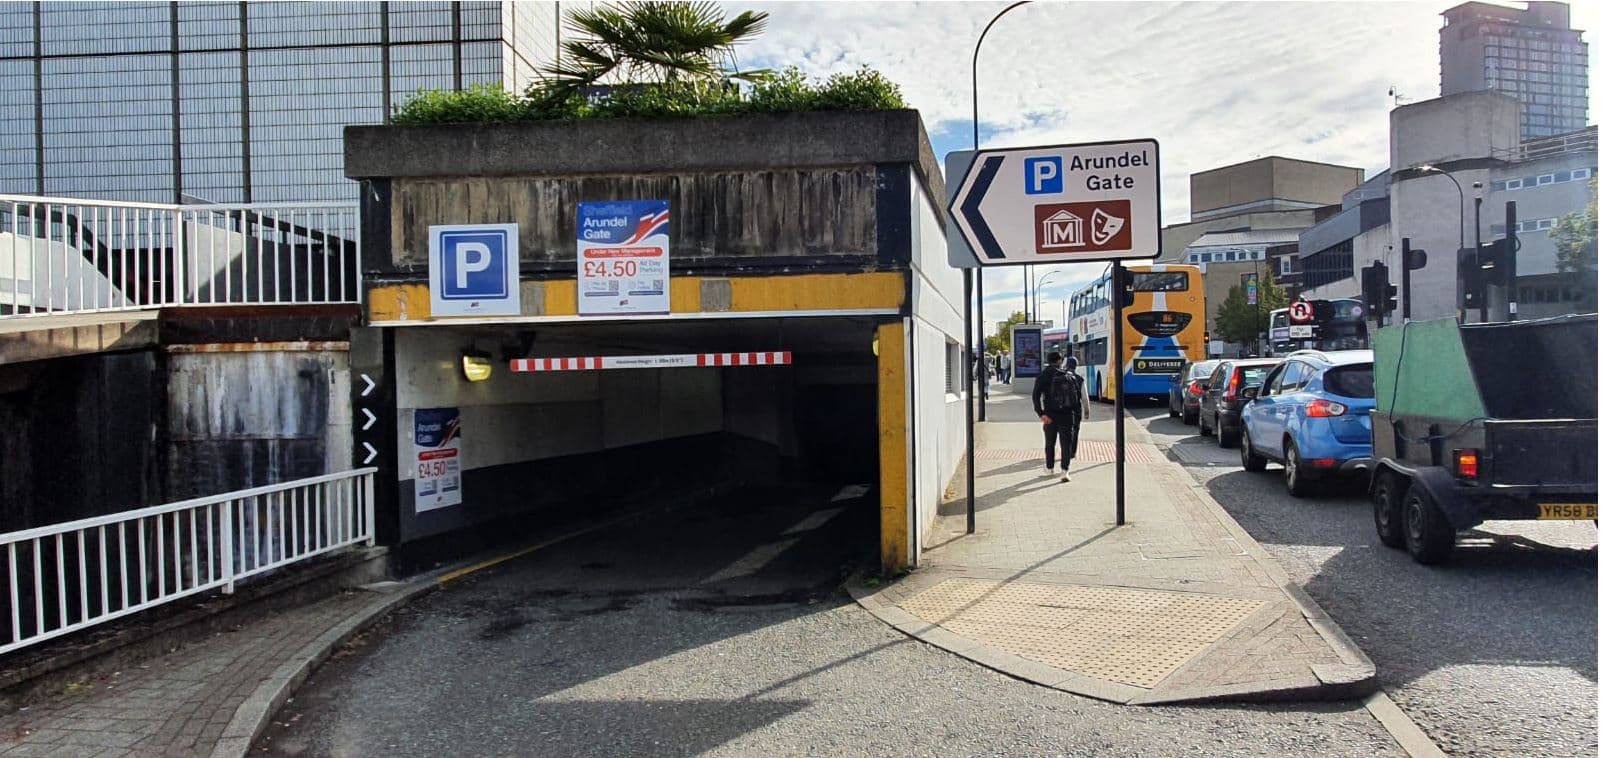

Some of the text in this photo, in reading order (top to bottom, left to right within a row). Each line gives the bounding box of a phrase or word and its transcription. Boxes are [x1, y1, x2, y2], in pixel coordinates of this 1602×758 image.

[1070, 150, 1149, 171] Arundel
[1033, 160, 1057, 192] P
[1086, 174, 1134, 191] Gate
[583, 204, 632, 216] Sheffield
[583, 216, 627, 227] Arundel
[583, 229, 611, 239] Gate
[455, 242, 492, 289] P
[584, 260, 637, 278] £4.50
[418, 460, 446, 478] £4.50
[1544, 505, 1582, 517] YR58
